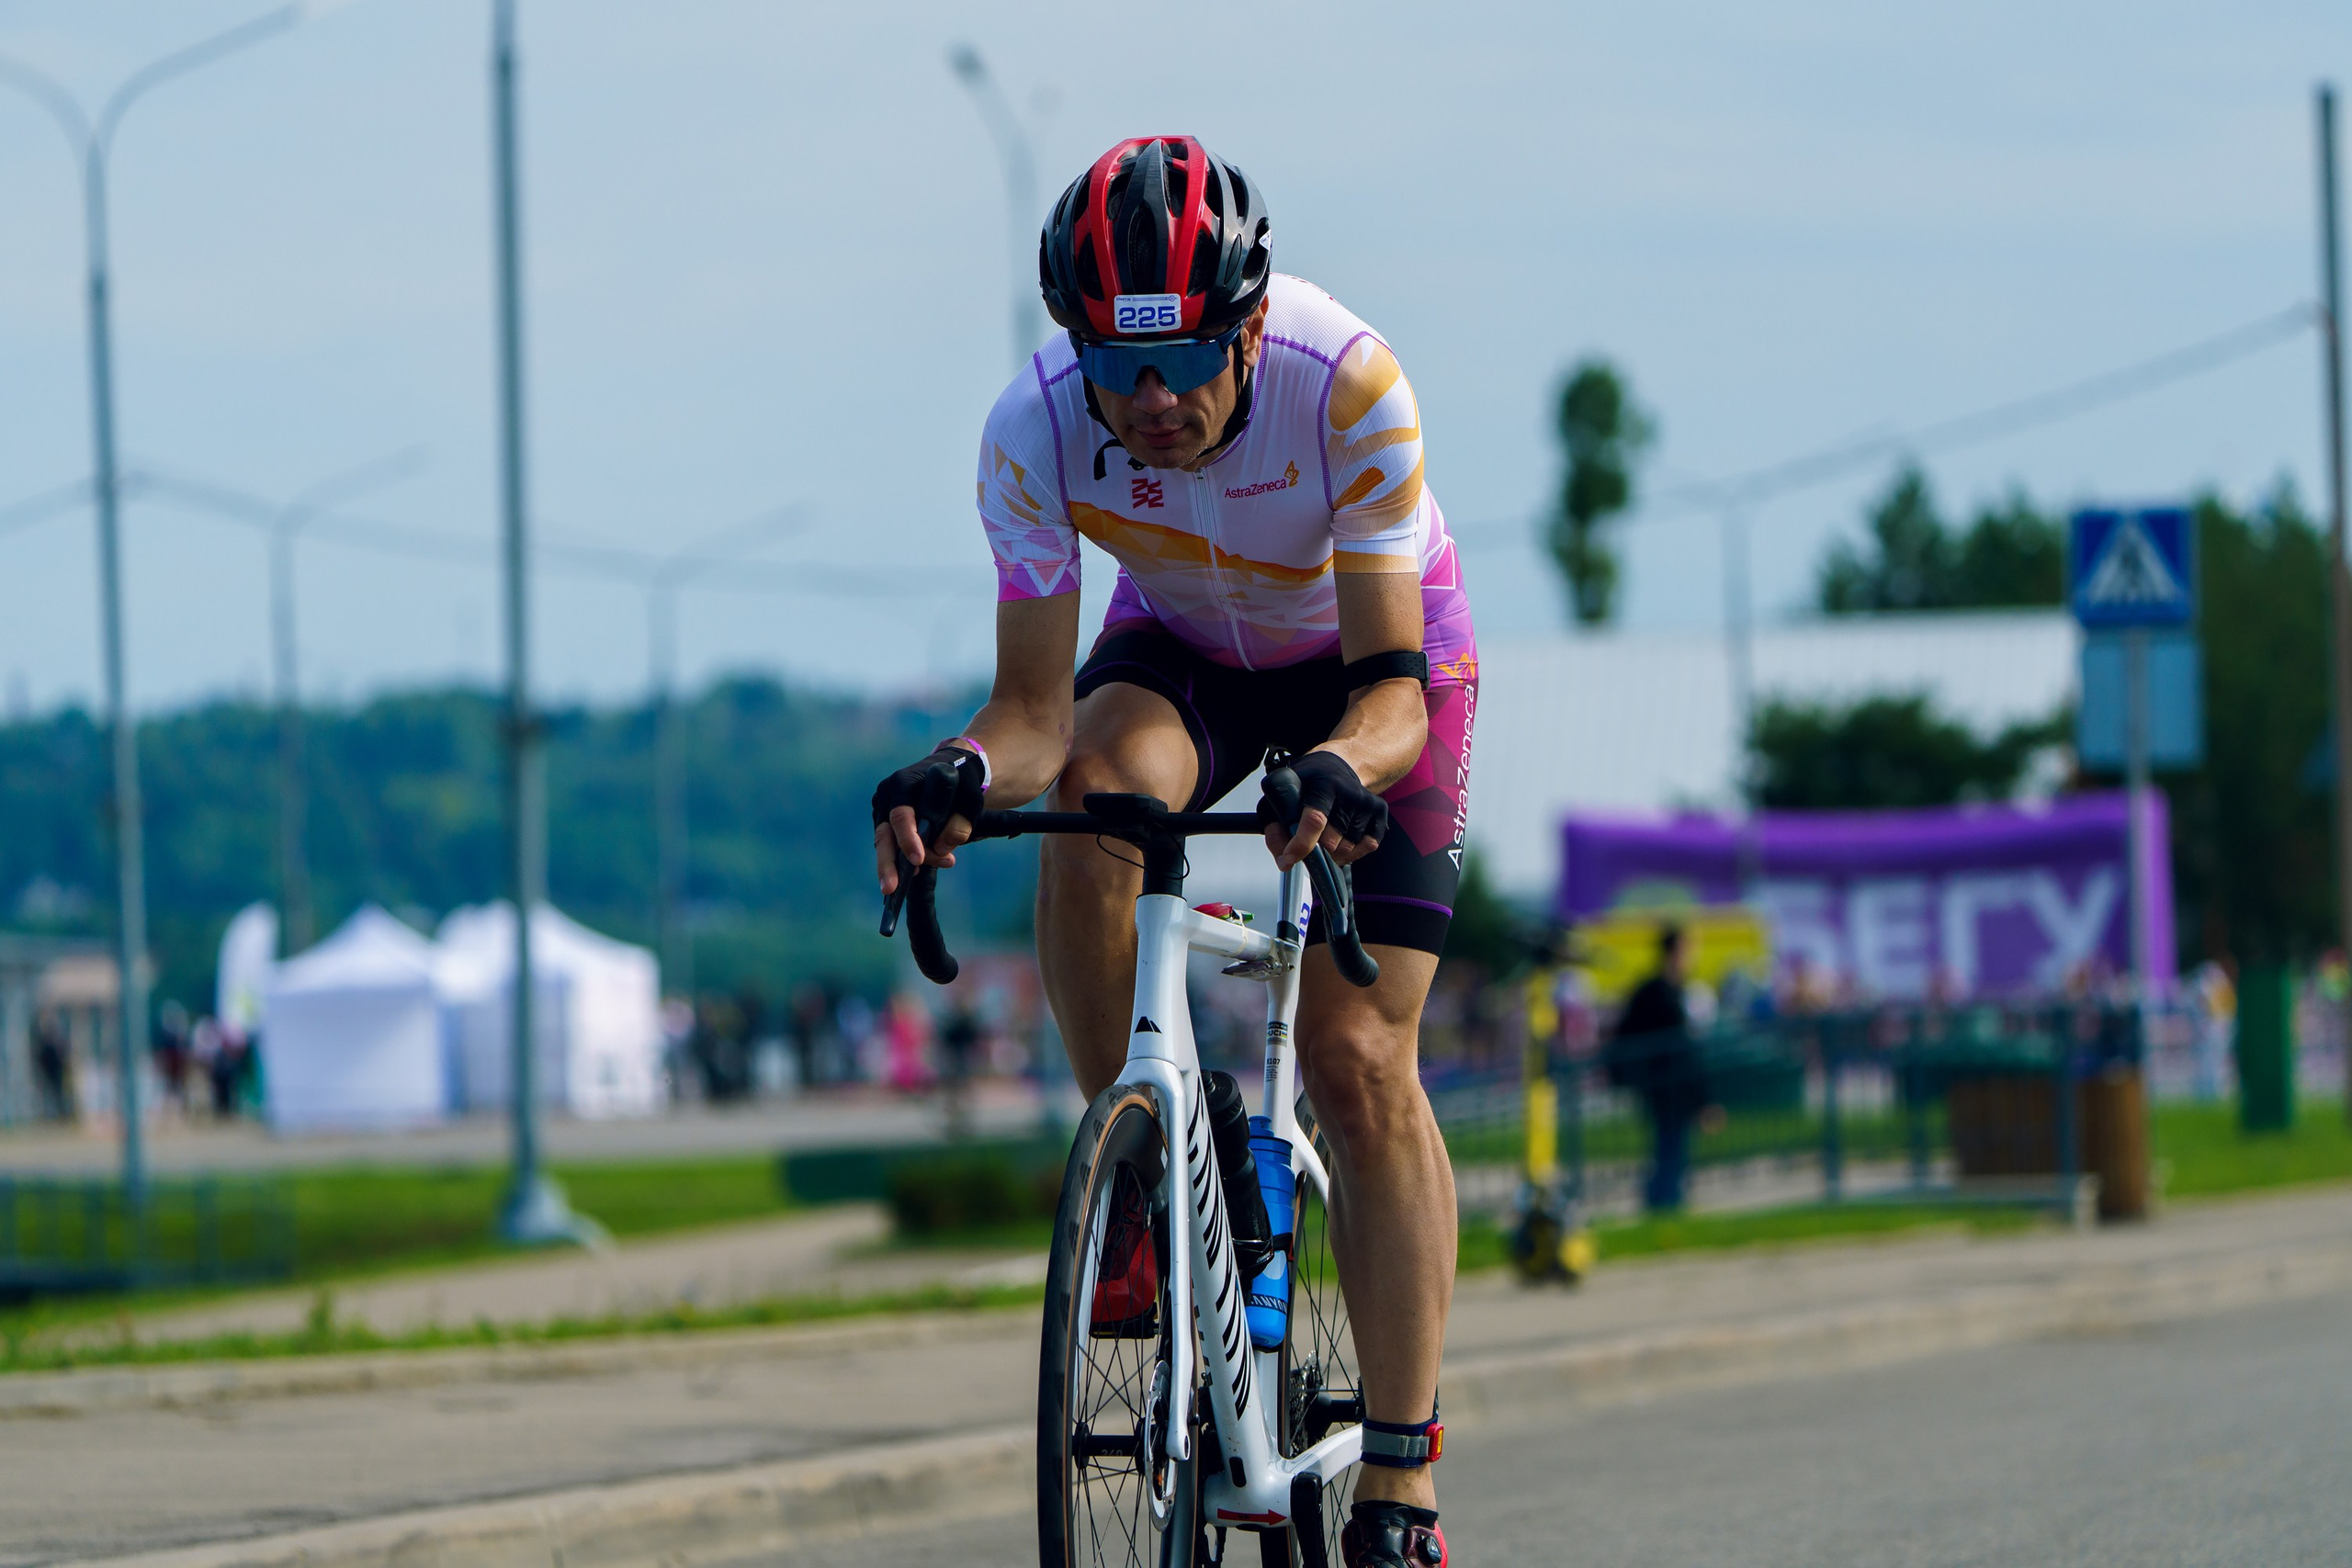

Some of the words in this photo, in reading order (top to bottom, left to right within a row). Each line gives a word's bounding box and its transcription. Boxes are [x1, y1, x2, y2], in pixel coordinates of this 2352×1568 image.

[1118, 305, 1177, 329] 225
[1224, 478, 1287, 499] AstraZeneca
[1447, 683, 1475, 871] AstraZeneca
